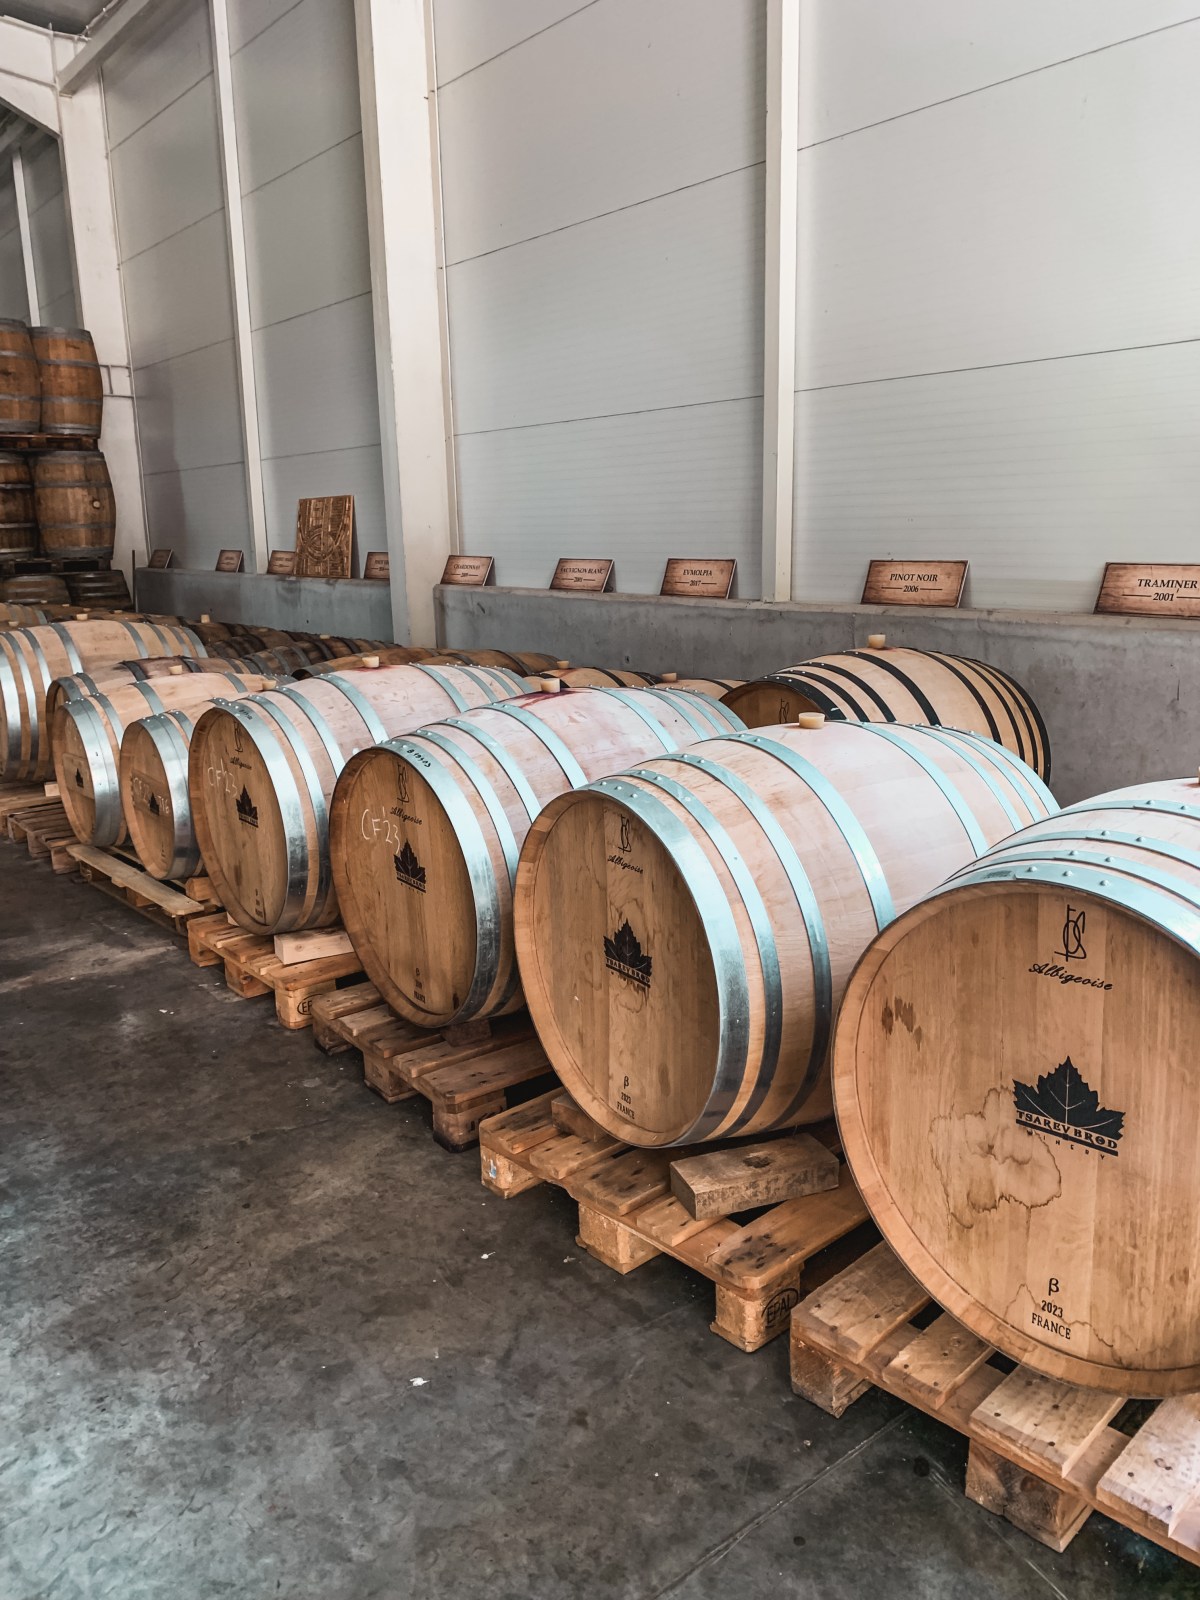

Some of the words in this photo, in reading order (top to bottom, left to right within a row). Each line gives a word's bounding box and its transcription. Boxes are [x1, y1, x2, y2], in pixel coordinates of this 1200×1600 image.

[889, 573, 915, 582] PINOT
[916, 574, 938, 582] NOIR
[1137, 579, 1198, 589] TRAMINER
[902, 584, 919, 593] 2006
[1152, 592, 1175, 602] 2001
[607, 853, 644, 875] Albigeoise
[1028, 962, 1114, 991] Albigeoise
[1041, 1300, 1063, 1319] 2023
[1031, 1312, 1071, 1340] FRANCE
